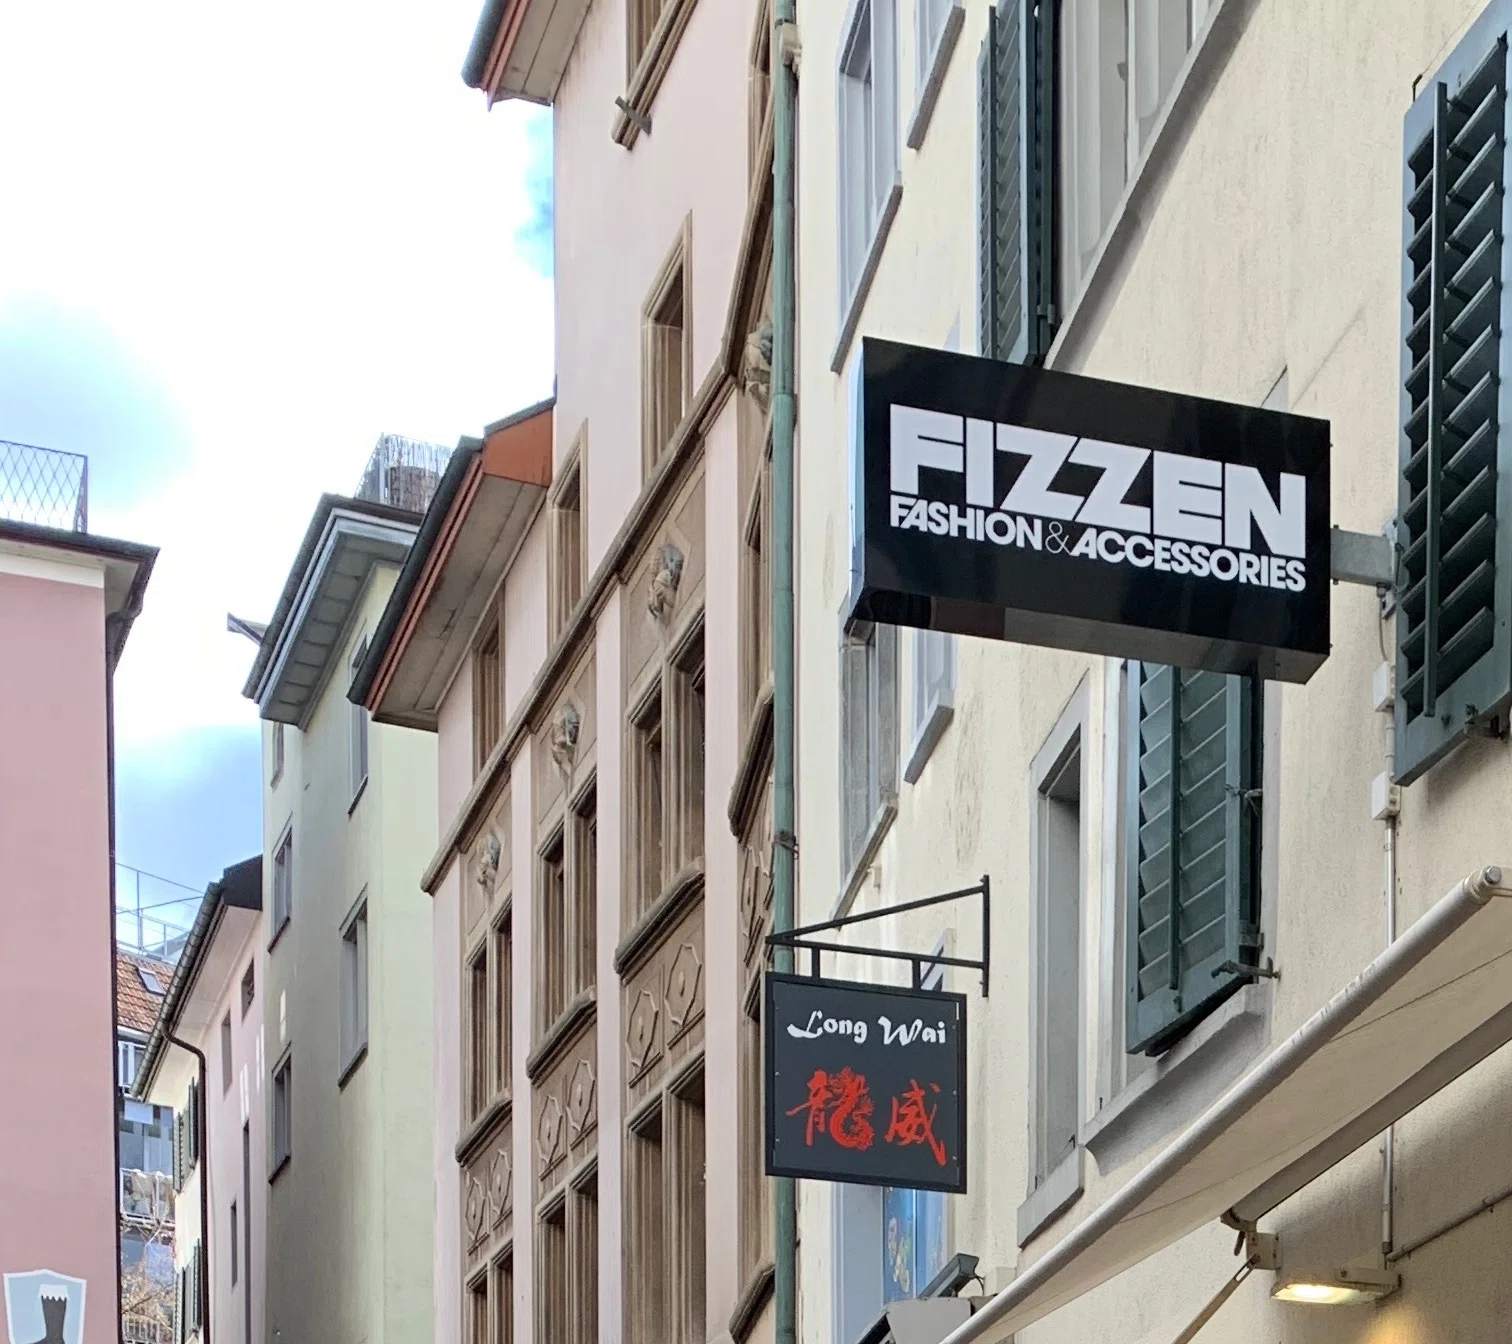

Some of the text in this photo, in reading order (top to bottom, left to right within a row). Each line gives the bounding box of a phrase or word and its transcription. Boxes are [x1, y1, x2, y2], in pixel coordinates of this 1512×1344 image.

[889, 403, 1306, 559] FIZZEN
[786, 1010, 947, 1046] Long Wai
